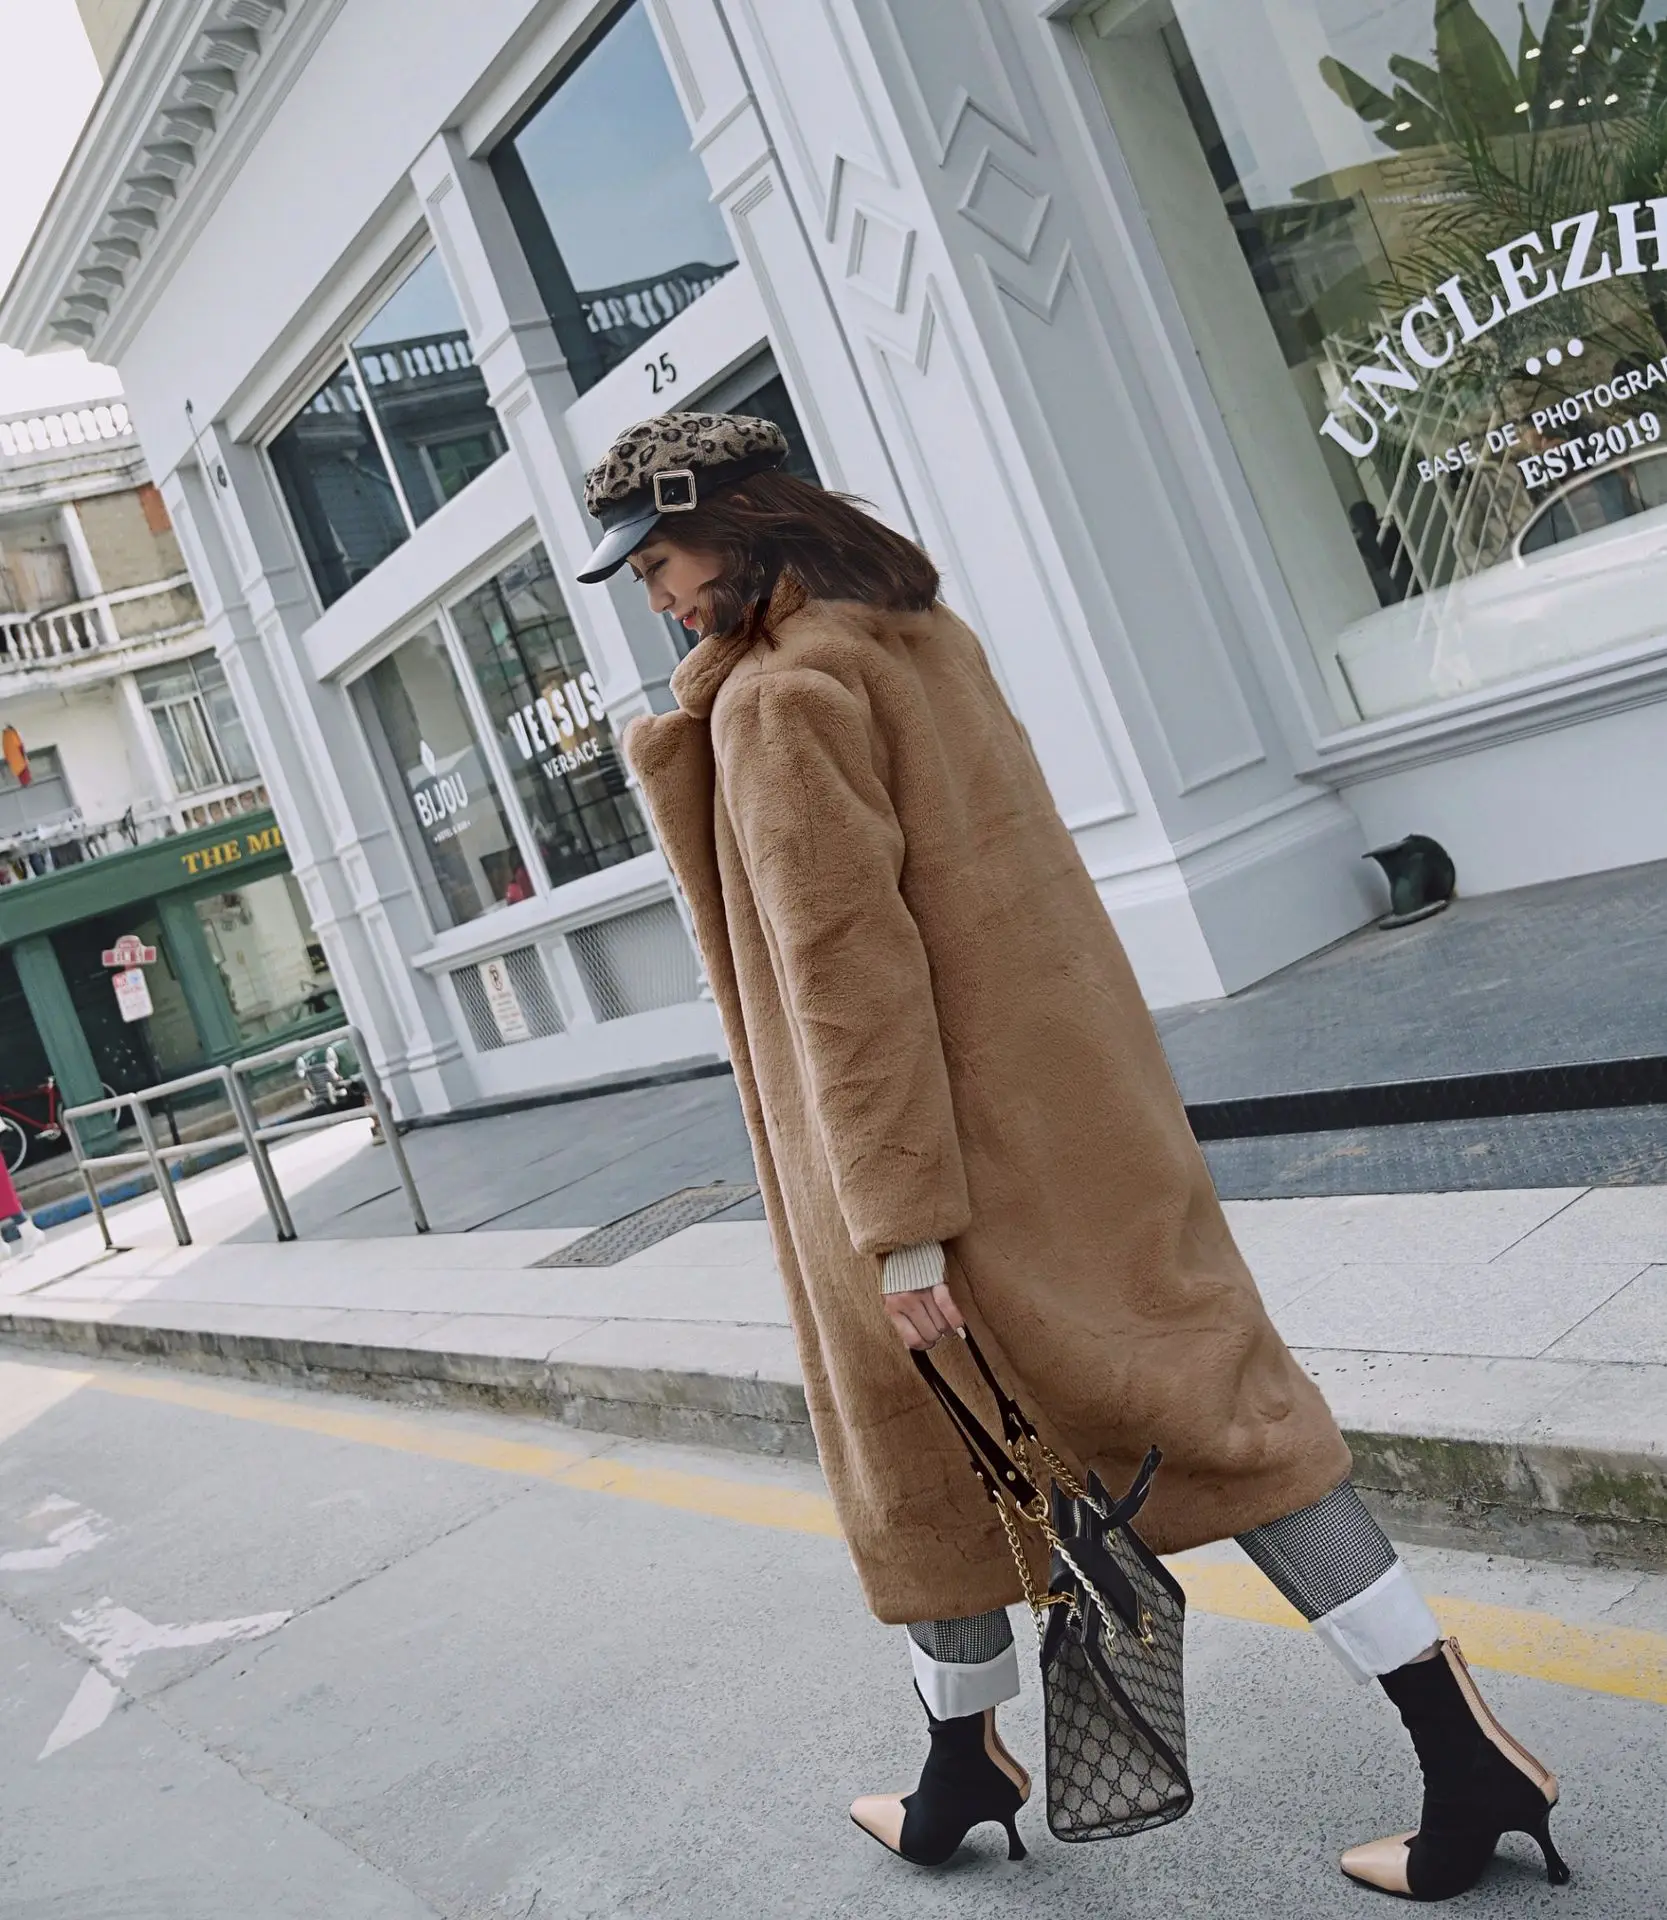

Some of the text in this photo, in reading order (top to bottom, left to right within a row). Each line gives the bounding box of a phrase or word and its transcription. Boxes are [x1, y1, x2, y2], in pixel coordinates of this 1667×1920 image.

[645, 352, 676, 394] 25
[1417, 441, 1477, 482] BASE
[1486, 423, 1520, 453] DE
[1517, 412, 1661, 488] EST.2019
[507, 671, 605, 760] VERSUS
[542, 738, 602, 779] VERSACE
[414, 771, 469, 827] BIJOU
[181, 840, 241, 875] THE
